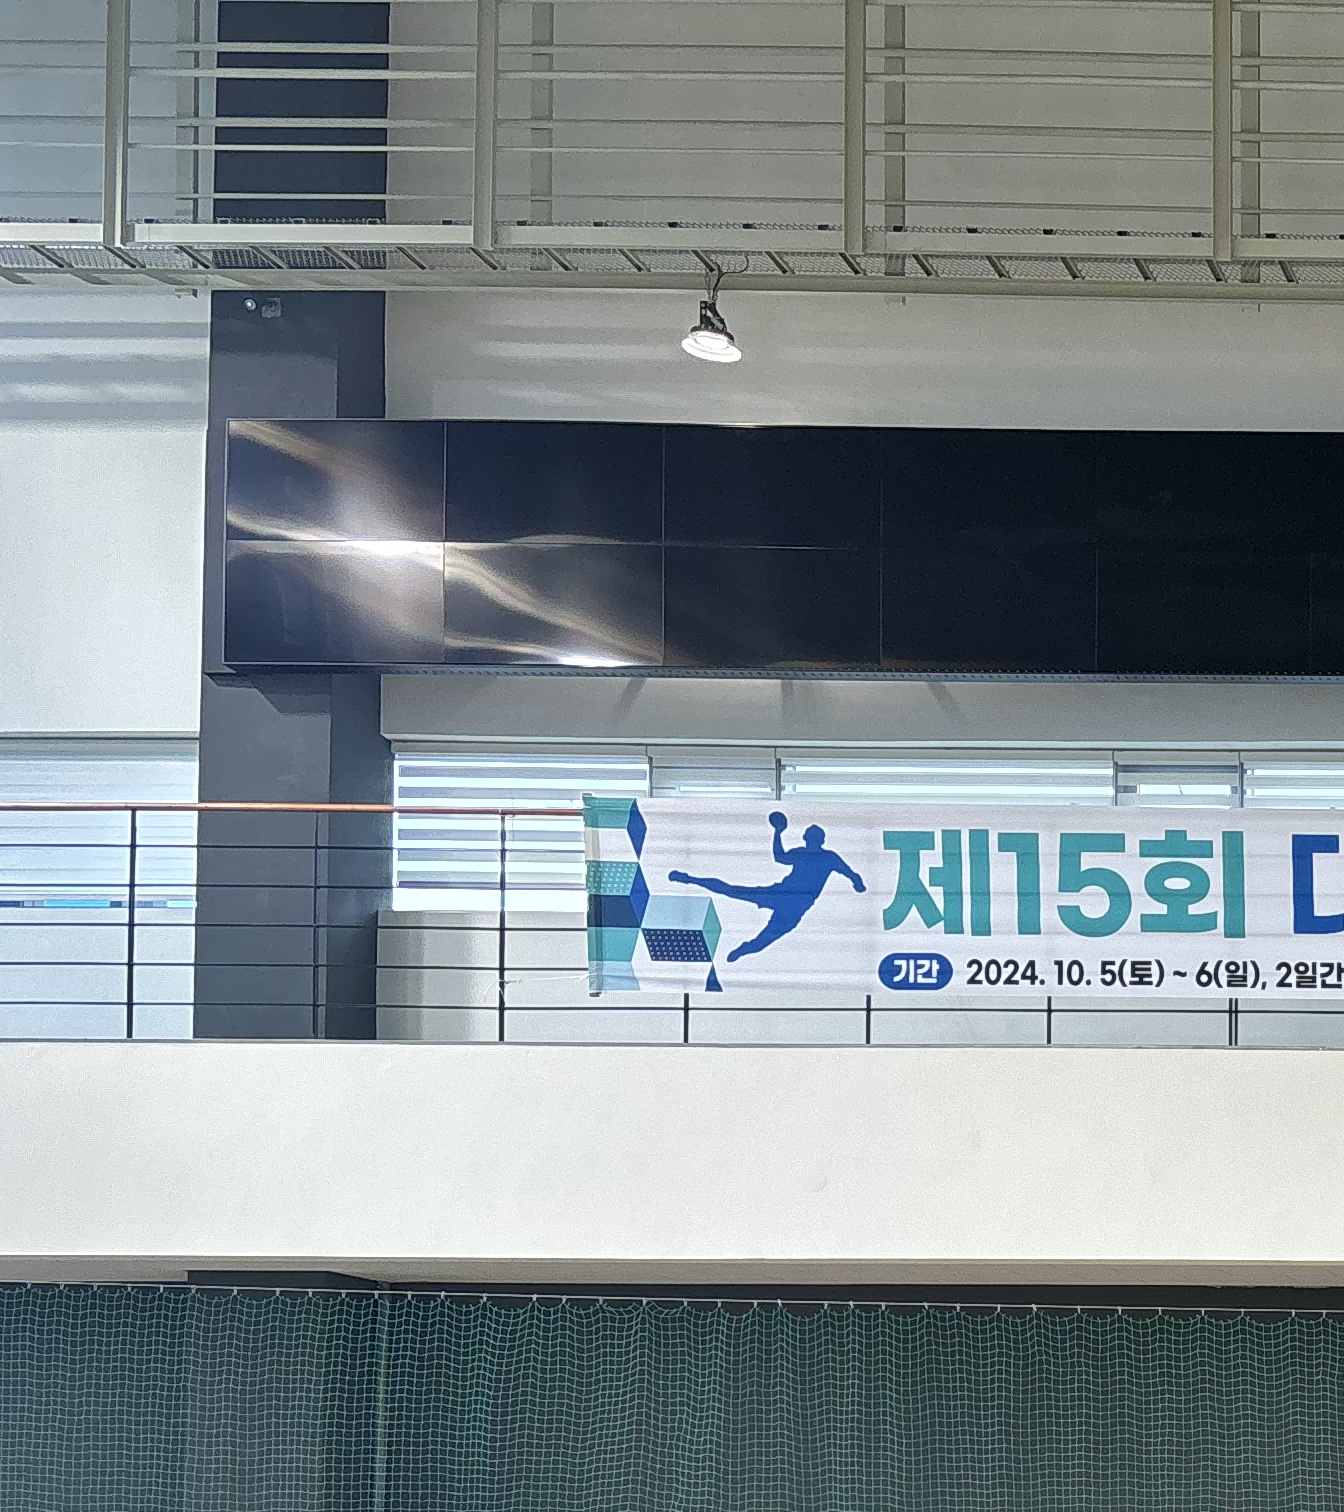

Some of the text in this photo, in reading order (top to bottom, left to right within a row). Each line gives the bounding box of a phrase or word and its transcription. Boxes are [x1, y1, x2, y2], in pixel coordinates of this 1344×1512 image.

[882, 828, 1244, 939] 제15회
[892, 958, 941, 984] 기간
[966, 959, 1045, 986] 2024.
[1055, 960, 1092, 987] 10.
[1099, 958, 1165, 989] 5(토)
[1195, 960, 1268, 991] 6(일),
[1275, 961, 1344, 989] 2일간
